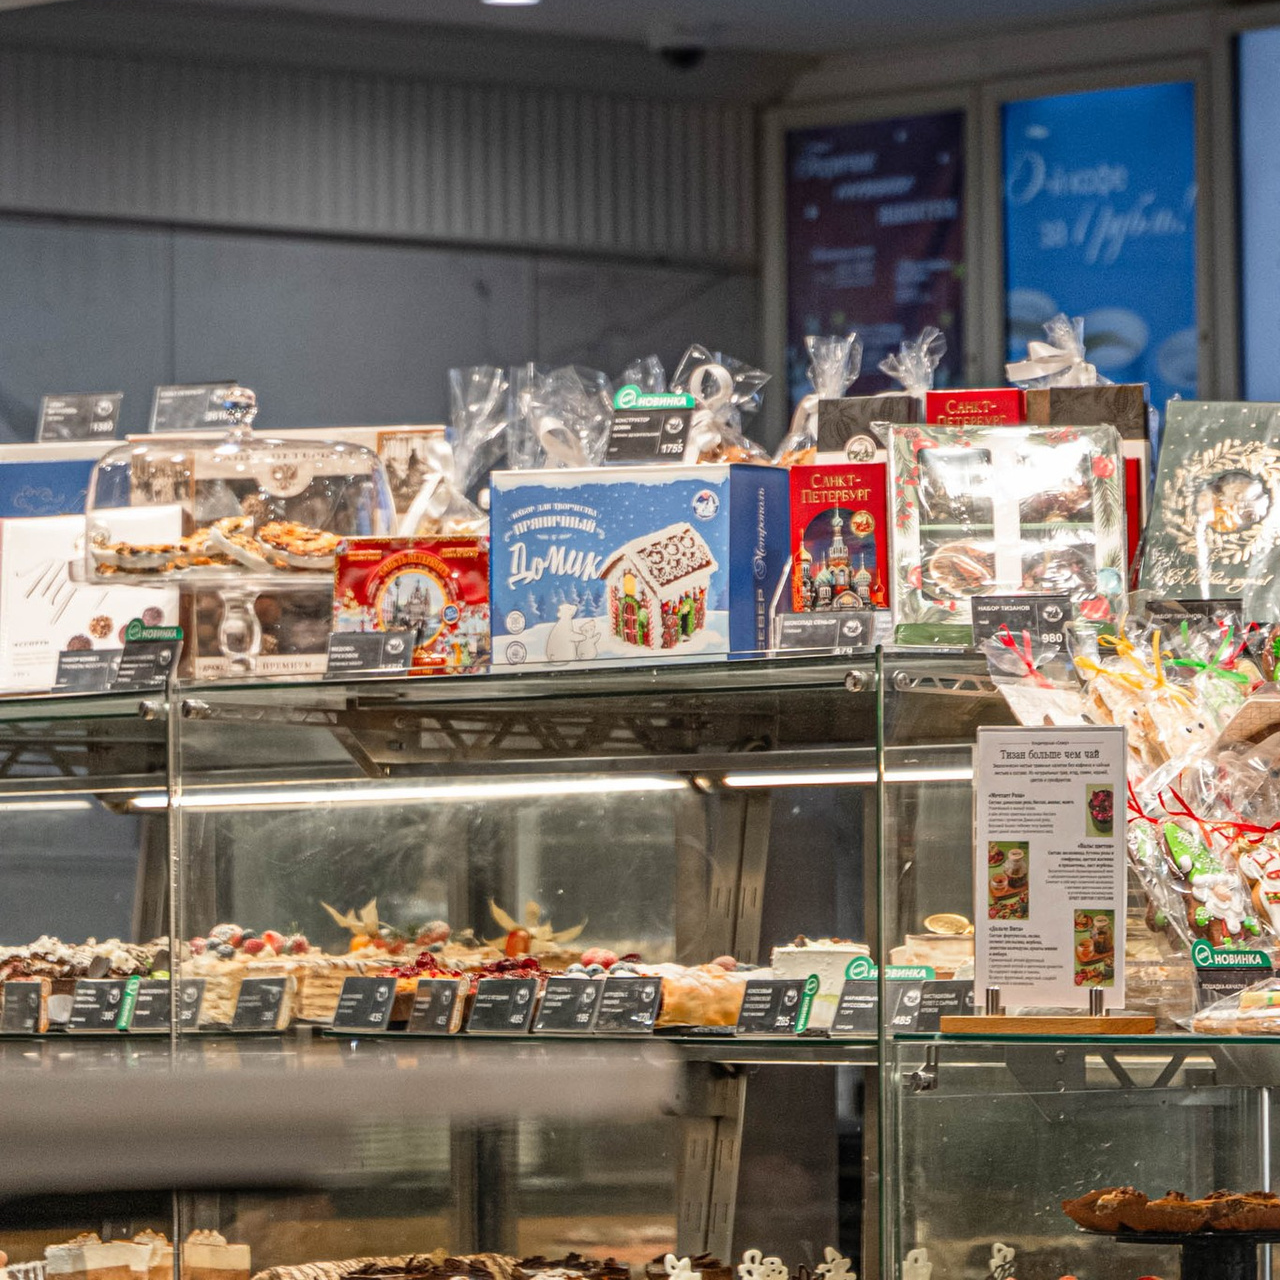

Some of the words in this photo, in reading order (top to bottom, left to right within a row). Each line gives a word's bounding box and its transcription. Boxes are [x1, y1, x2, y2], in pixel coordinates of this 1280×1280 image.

[638, 396, 687, 407] НОВИНКА
[660, 443, 684, 453] 1755
[811, 474, 861, 488] САНКТ-
[801, 489, 872, 504] ПЕТЕРБУРГ
[554, 502, 598, 517] ТВОРЧЕСТВА
[513, 515, 597, 536] ПРЯНИЧНЫЙ
[1041, 633, 1063, 643] 980
[1000, 750, 1026, 759] Тизан
[1028, 749, 1062, 759] больше
[1085, 750, 1100, 759] чай
[1213, 952, 1263, 967] НОВИНКА
[869, 968, 927, 979] НОВИНКА
